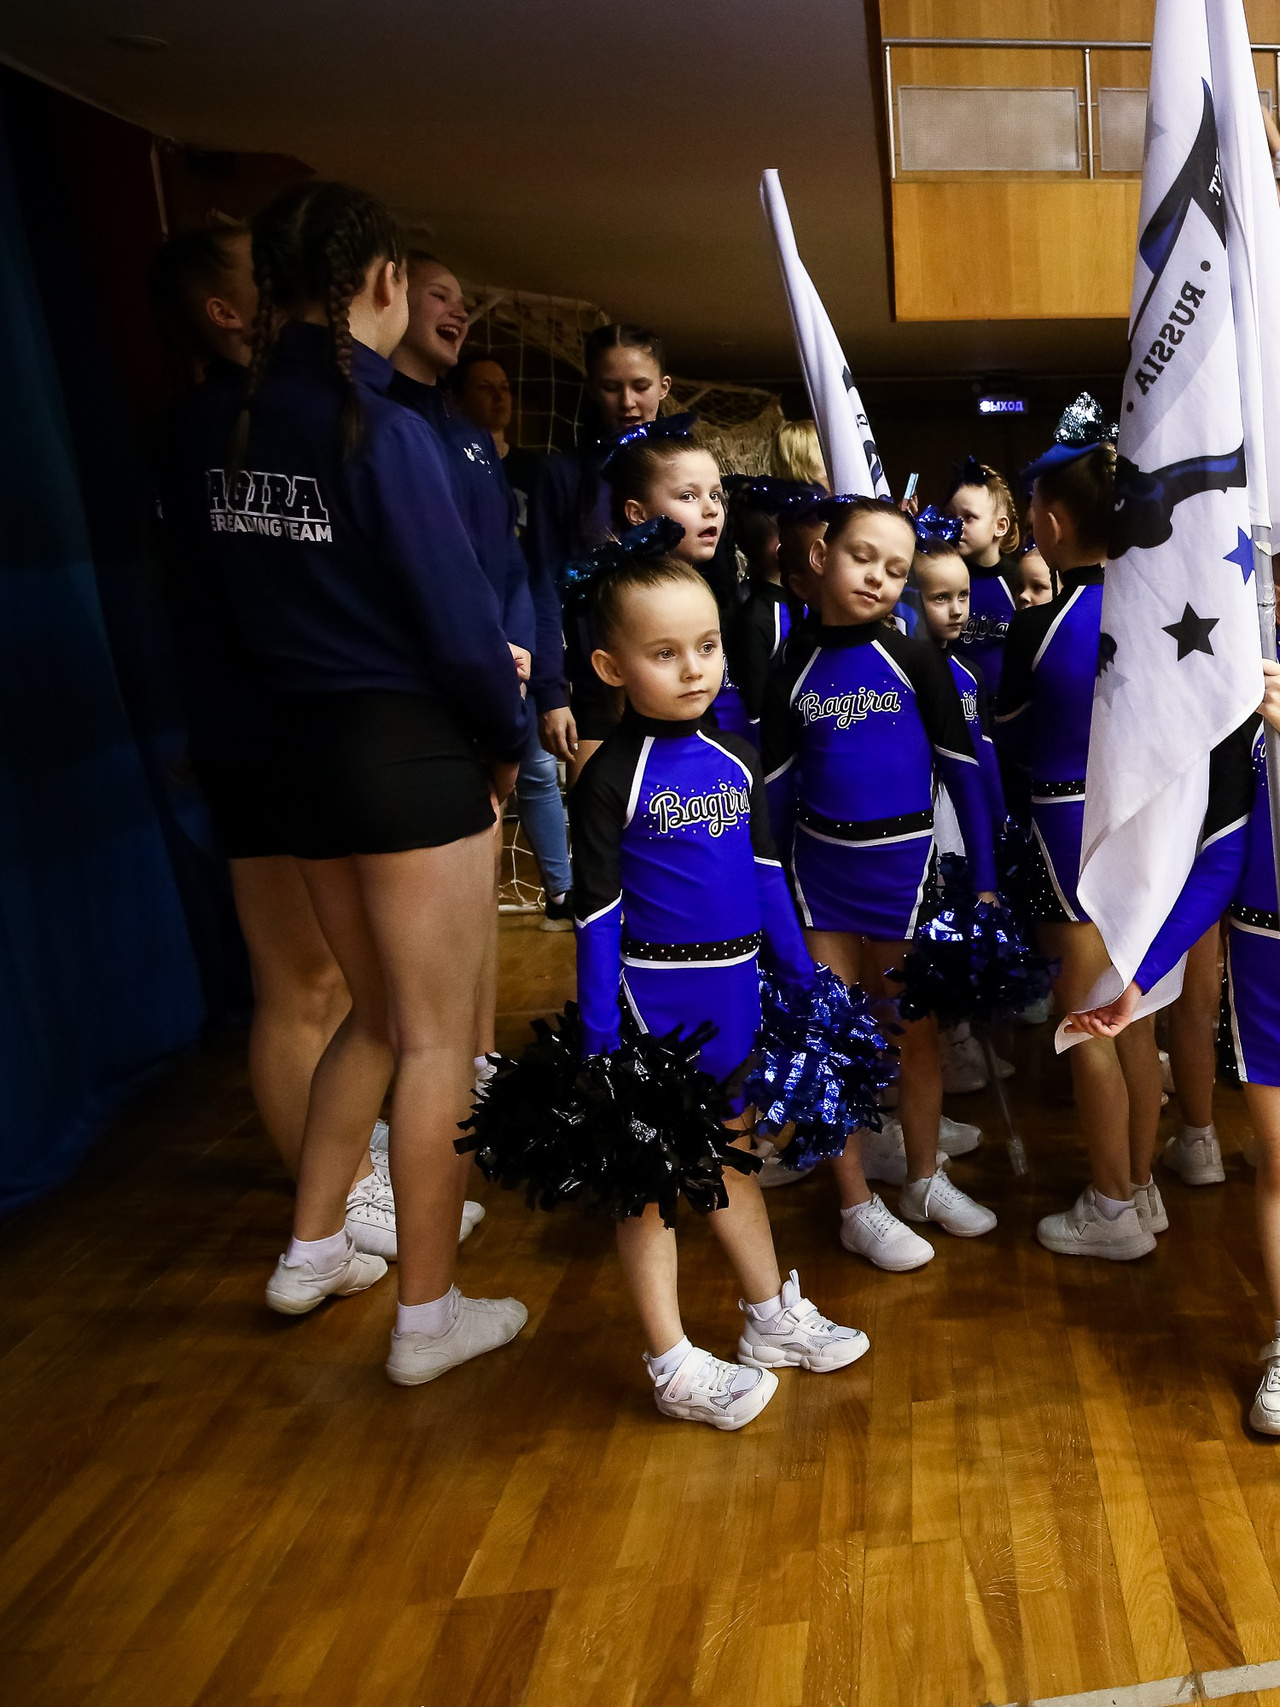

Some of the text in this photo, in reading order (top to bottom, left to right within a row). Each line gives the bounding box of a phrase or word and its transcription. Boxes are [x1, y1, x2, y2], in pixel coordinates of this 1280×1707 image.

[205, 468, 330, 523] AGIRA
[283, 521, 333, 543] TEAM
[798, 686, 901, 729] Bagira
[649, 783, 750, 838] Bagira
